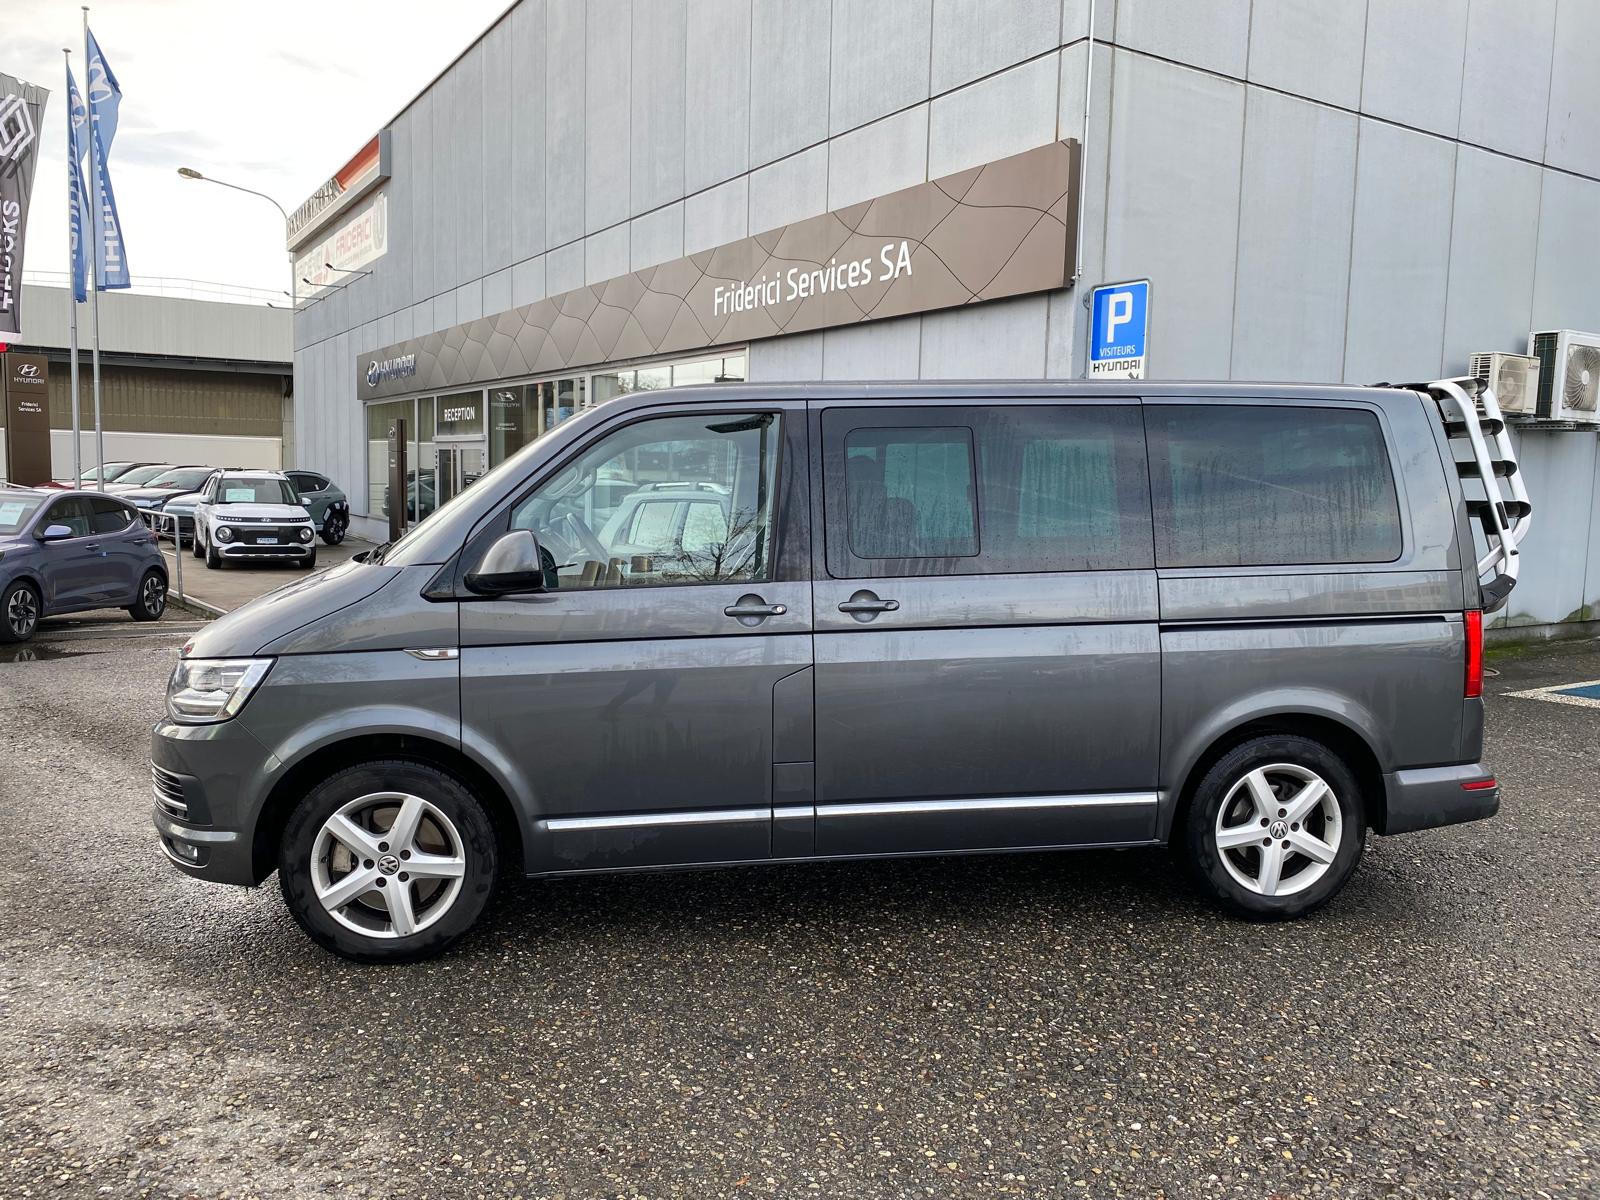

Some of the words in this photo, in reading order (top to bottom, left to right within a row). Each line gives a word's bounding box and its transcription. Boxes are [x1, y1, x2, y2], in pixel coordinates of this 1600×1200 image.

[714, 272, 780, 316] Friderici
[787, 258, 872, 301] Services
[879, 240, 912, 282] SA
[1107, 291, 1133, 343] P
[1100, 345, 1135, 357] VISITEURS
[1093, 359, 1140, 373] HYUNDAI
[13, 377, 45, 385] HYUNDAI
[444, 406, 475, 422] RECEPTION
